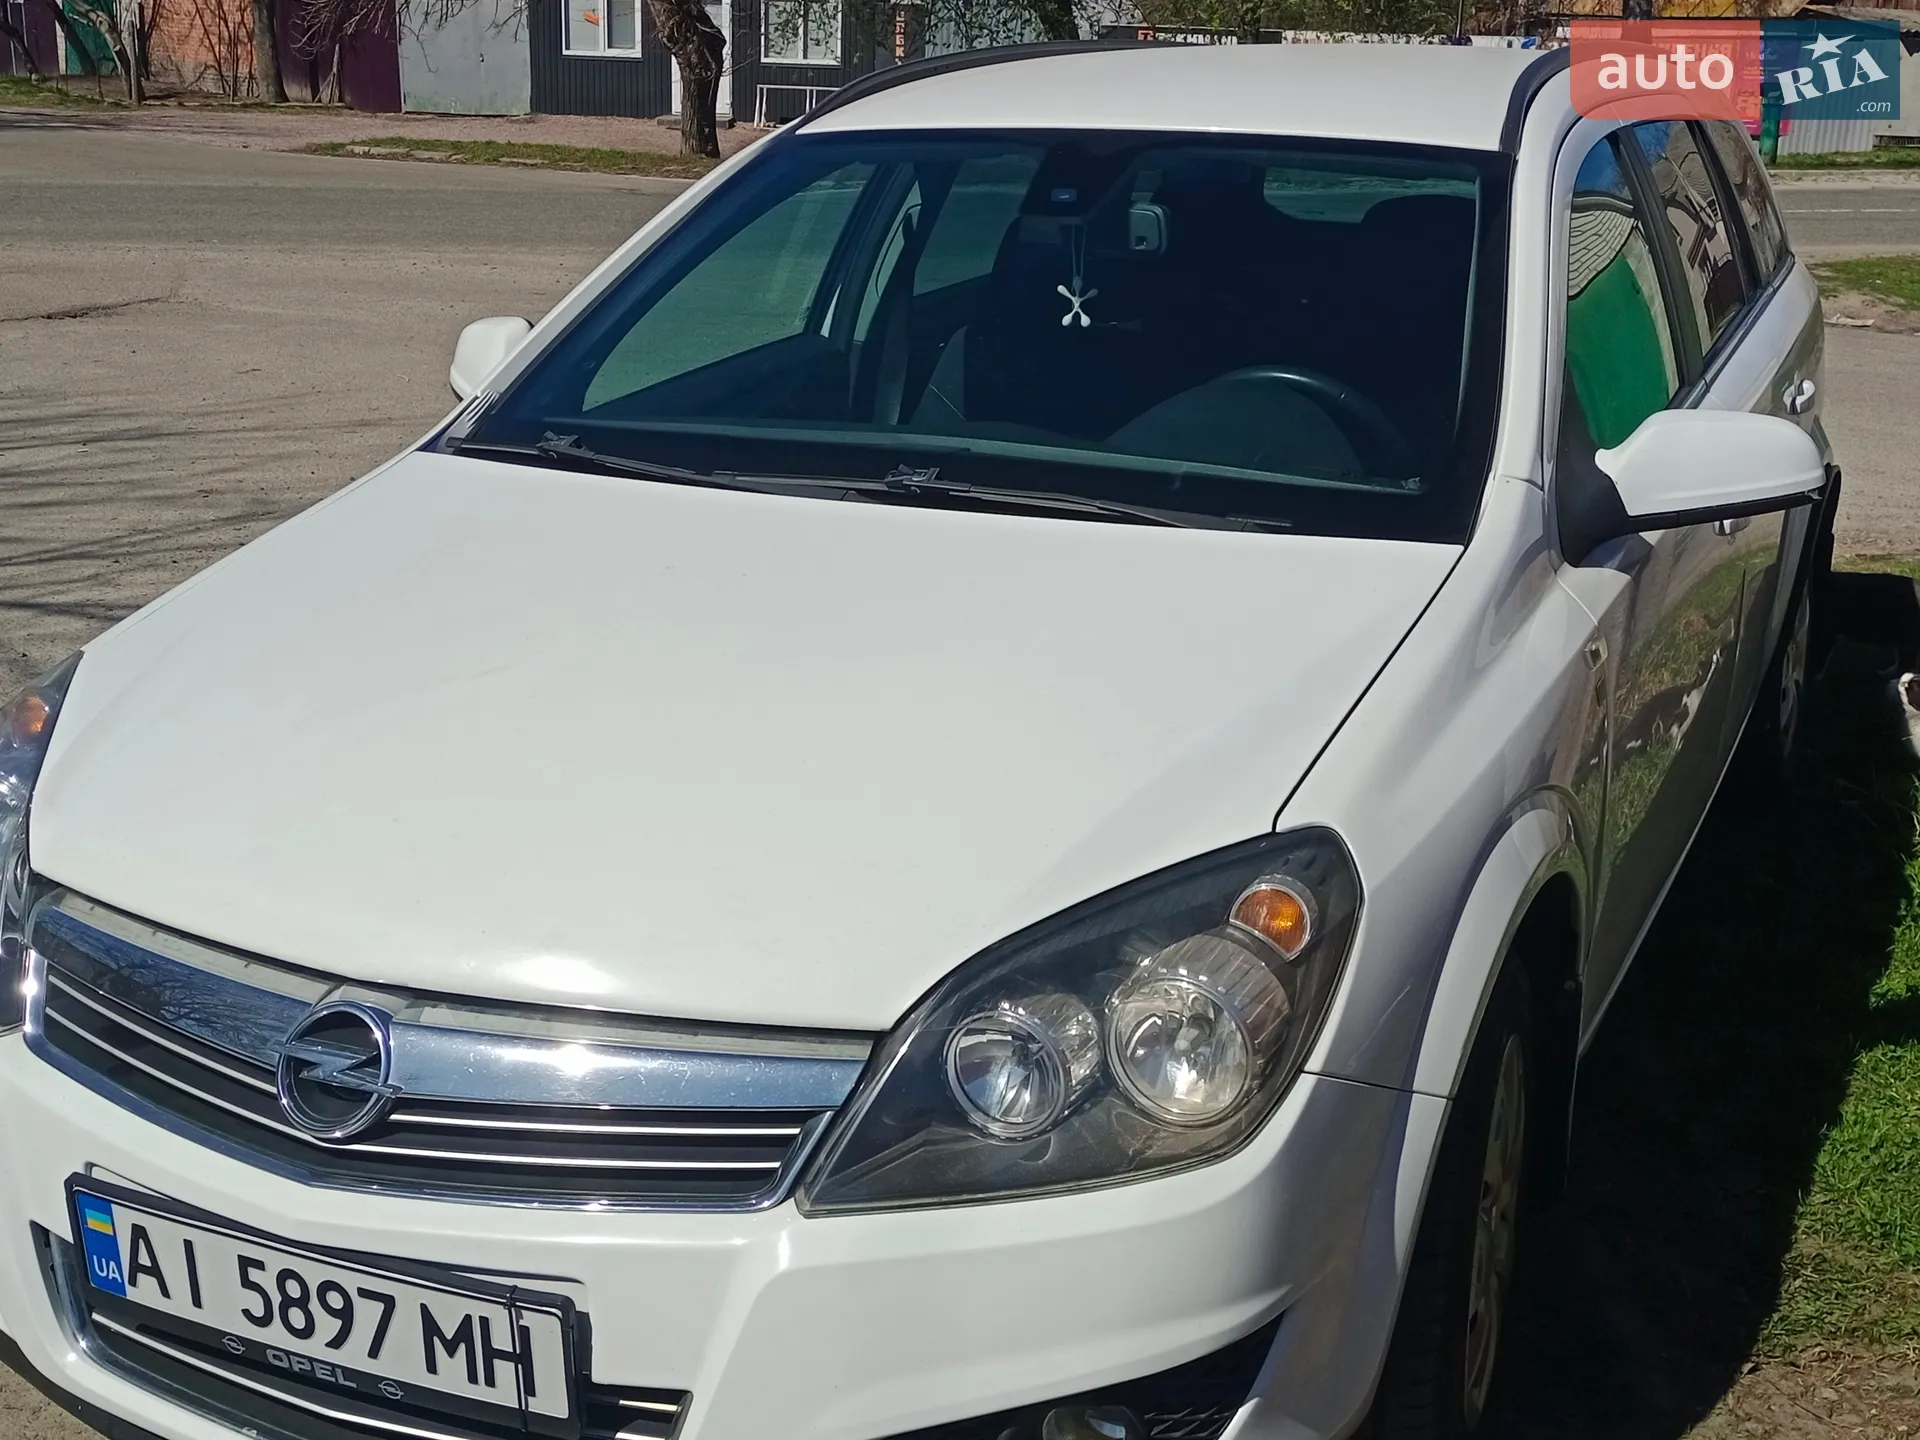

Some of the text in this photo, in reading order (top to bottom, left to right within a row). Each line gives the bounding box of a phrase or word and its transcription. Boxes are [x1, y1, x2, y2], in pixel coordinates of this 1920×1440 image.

[93, 1257, 122, 1283] UA
[128, 1223, 536, 1398] AI 5897 MH
[266, 1349, 358, 1389] OPEL
